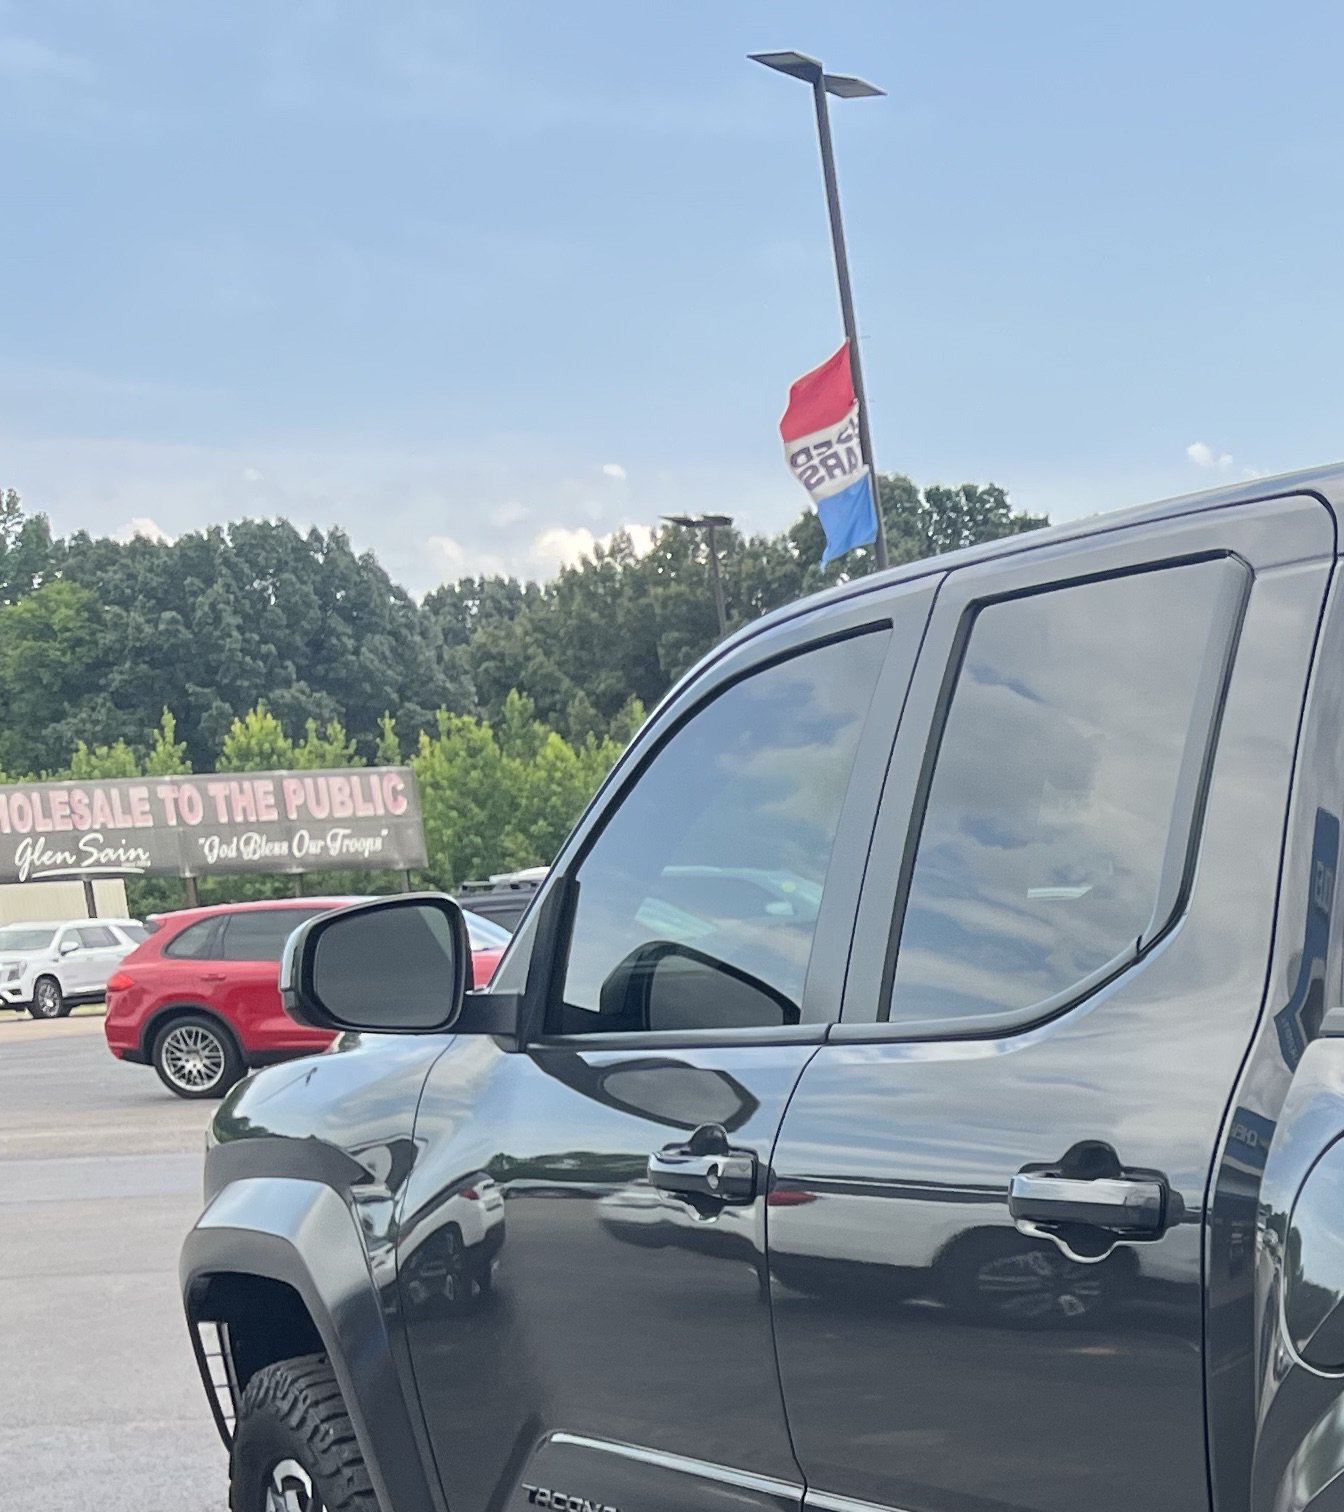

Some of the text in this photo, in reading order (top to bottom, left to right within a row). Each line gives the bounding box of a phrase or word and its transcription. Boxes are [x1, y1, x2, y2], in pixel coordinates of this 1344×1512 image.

[157, 782, 204, 827] TO
[207, 778, 279, 824] THE
[282, 772, 408, 821] PUBLIC
[15, 832, 150, 882] Glen Sain
[239, 831, 289, 860] Bless
[292, 829, 325, 858] Our
